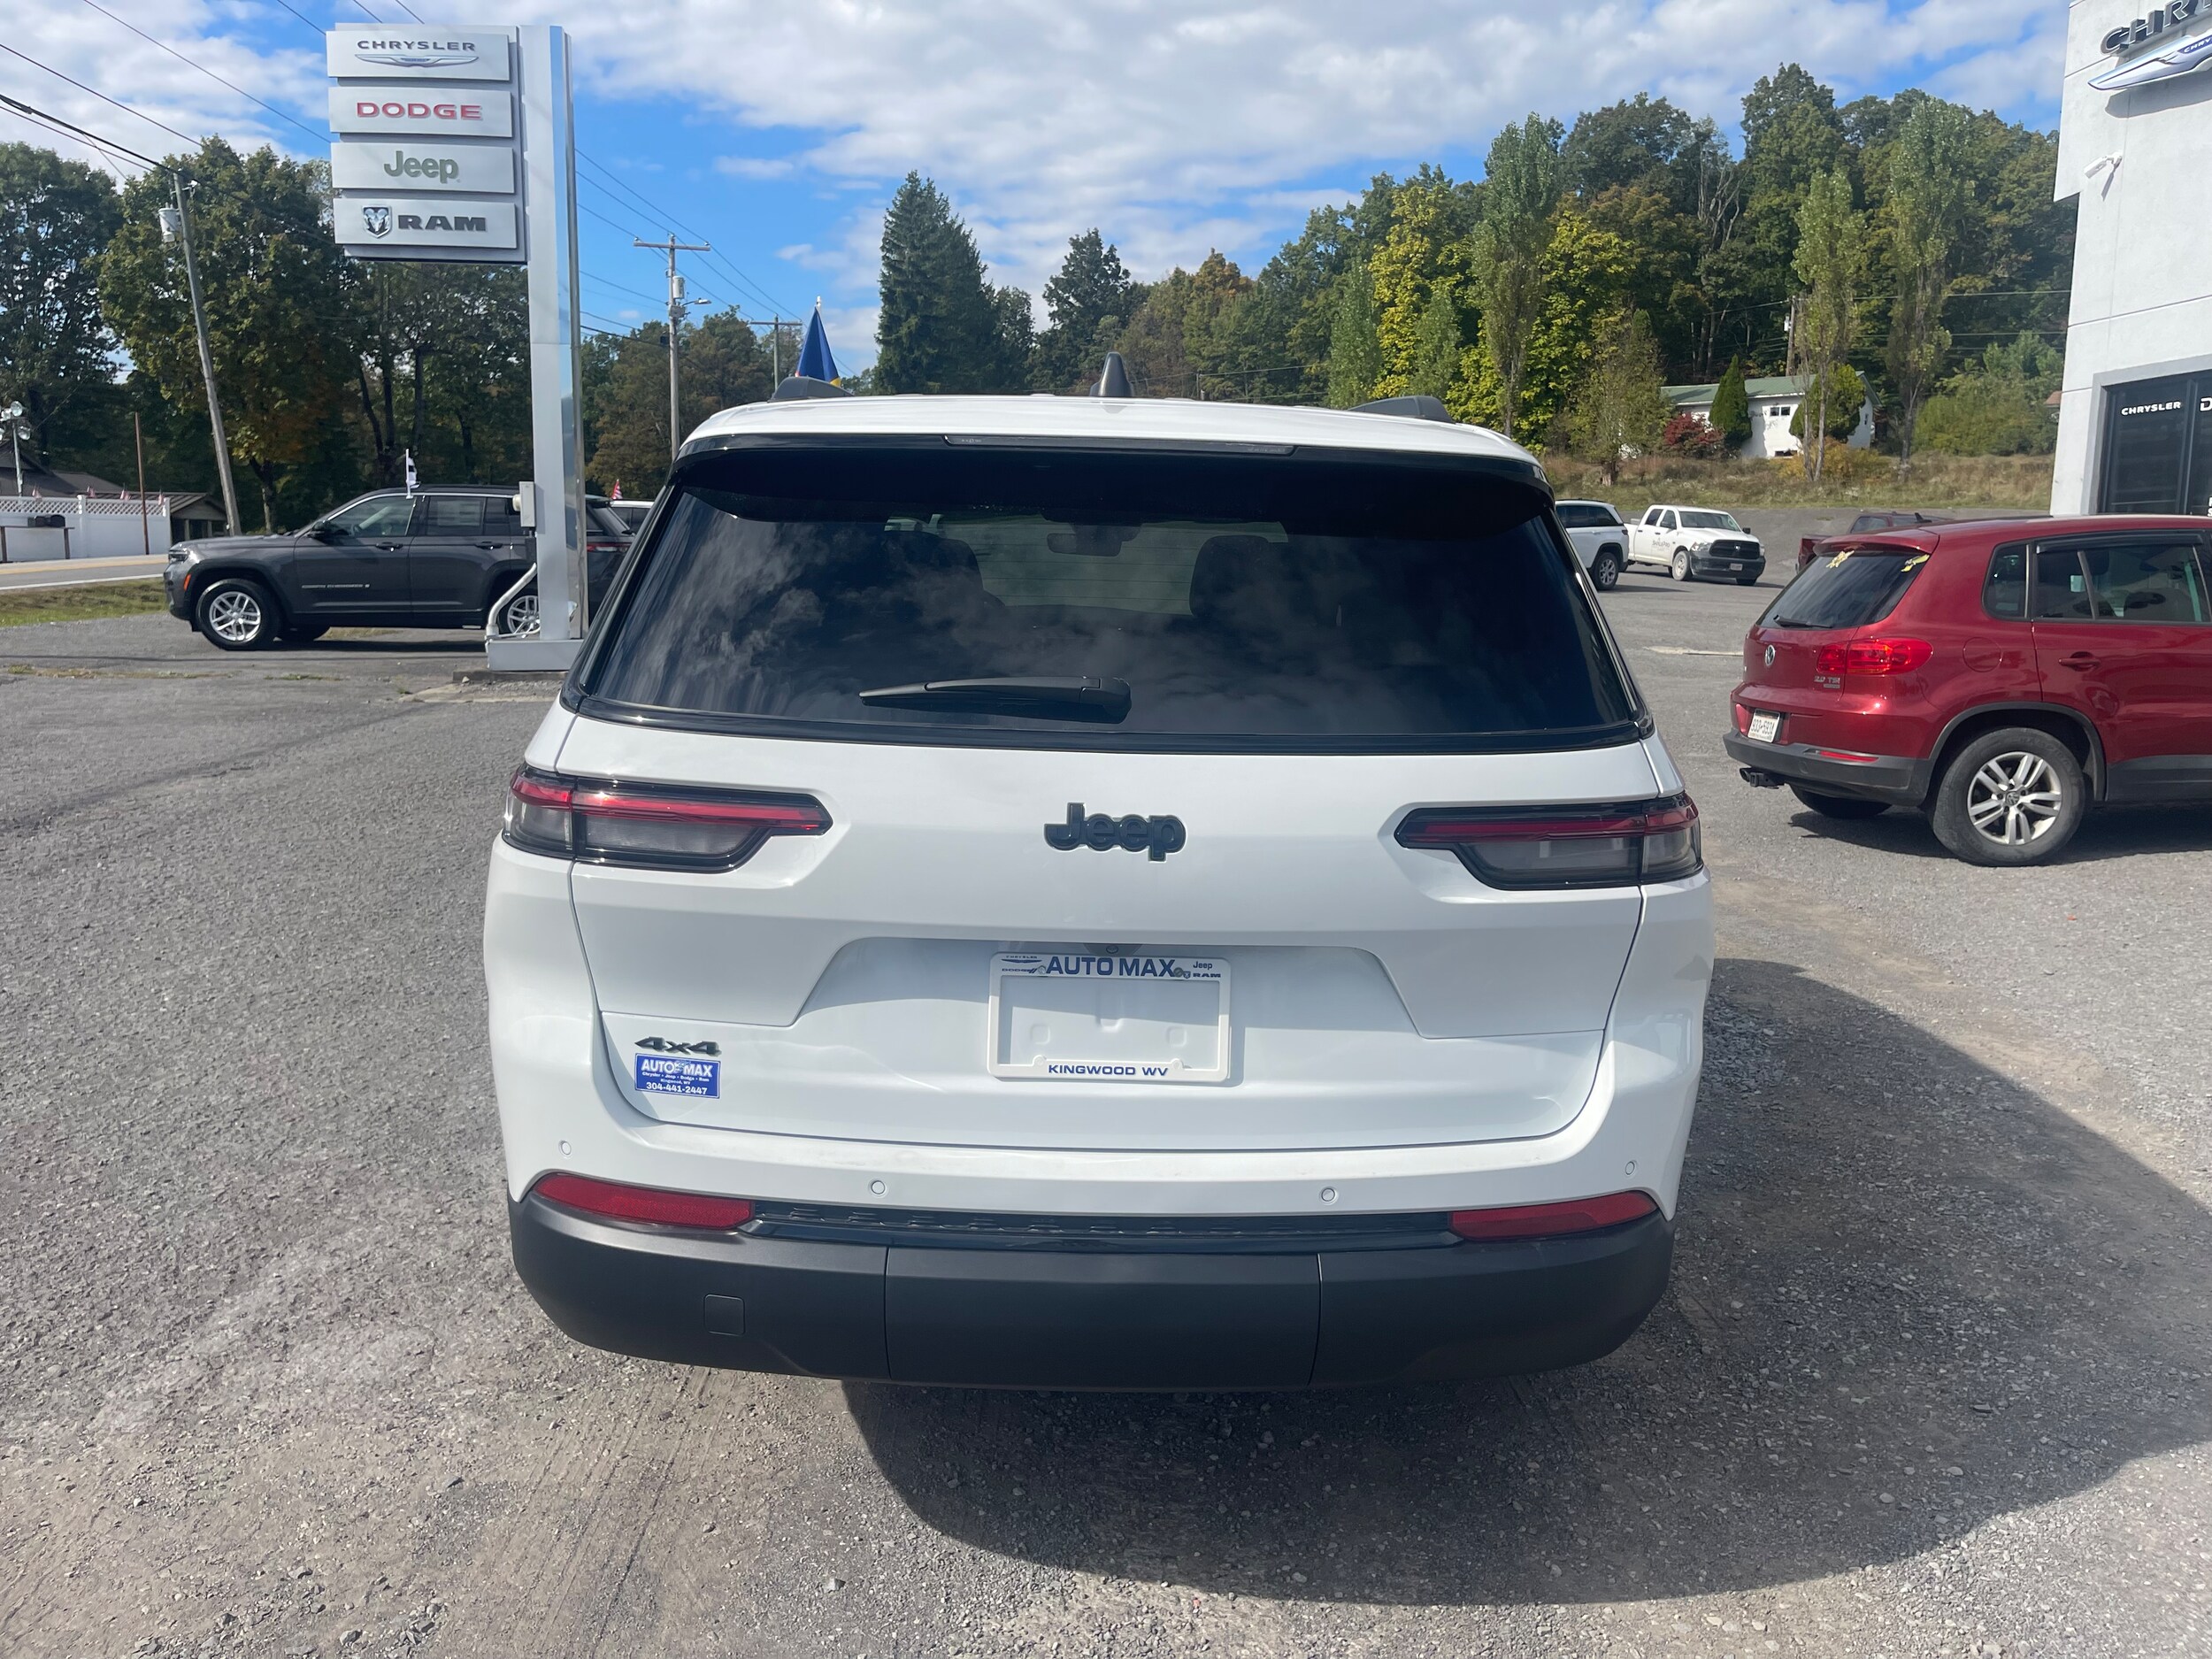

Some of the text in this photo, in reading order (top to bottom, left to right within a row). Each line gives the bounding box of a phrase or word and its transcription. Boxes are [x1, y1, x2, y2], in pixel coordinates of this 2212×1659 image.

[2100, 0, 2212, 55] CHR
[357, 41, 476, 51] CHRYSLER
[357, 102, 483, 120] DODGE
[384, 150, 459, 183] Jeep
[397, 214, 487, 232] RAM
[2121, 401, 2182, 416] CHRYSLER
[1044, 803, 1187, 862] Jeep
[1046, 956, 1175, 978] AUTO MAX
[1193, 961, 1213, 971] Jeep
[641, 1059, 713, 1077] AUTO MAX
[1048, 1064, 1169, 1076] KINGWOOD WV
[646, 1082, 708, 1094] 304-441-2447
